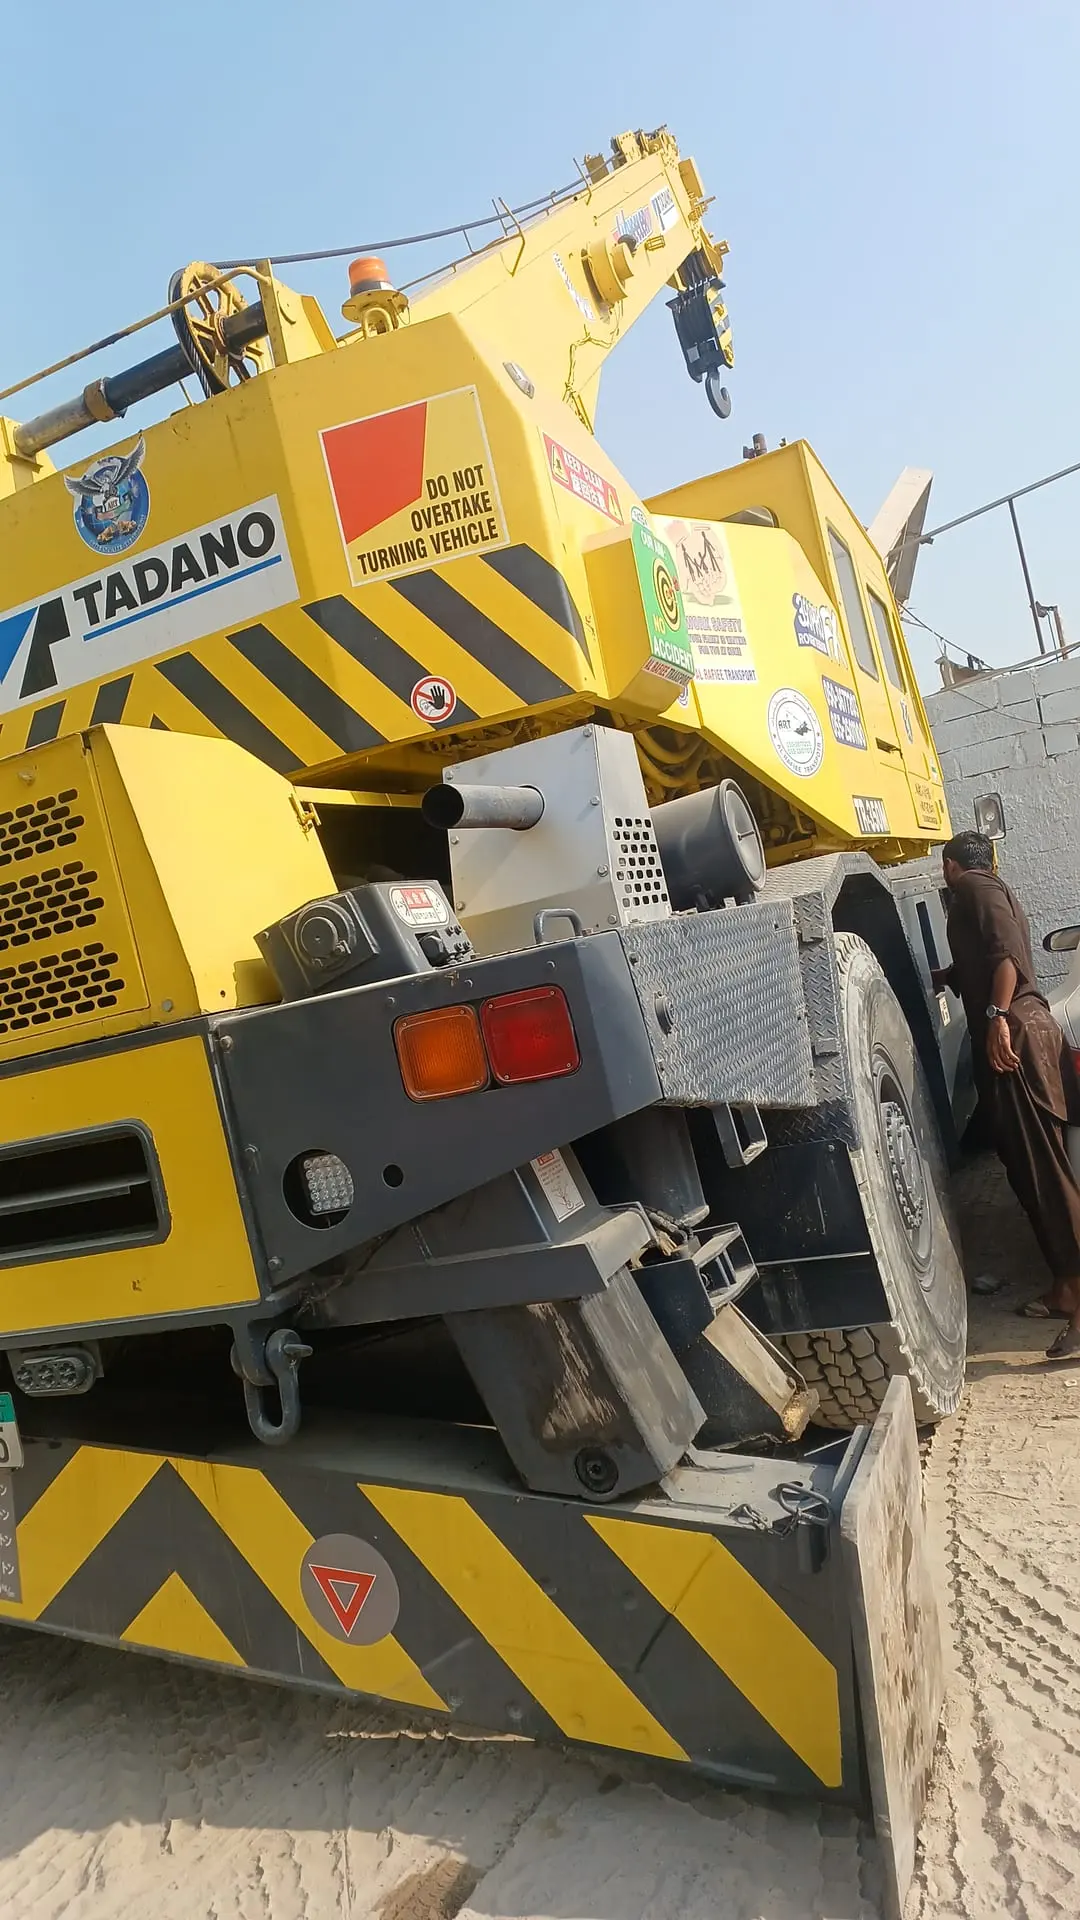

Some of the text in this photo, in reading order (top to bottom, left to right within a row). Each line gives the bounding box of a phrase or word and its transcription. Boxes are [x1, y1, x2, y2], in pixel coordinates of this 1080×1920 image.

[425, 464, 484, 500] DO NOT
[411, 491, 493, 532] OVERTAKE
[357, 517, 499, 575] TURNING VEHICLE
[72, 511, 276, 627] TADANO
[653, 613, 667, 635] NO
[711, 617, 742, 633] SAFETY
[653, 635, 694, 674] ACCIDENT
[724, 669, 757, 681] TRANSPORT
